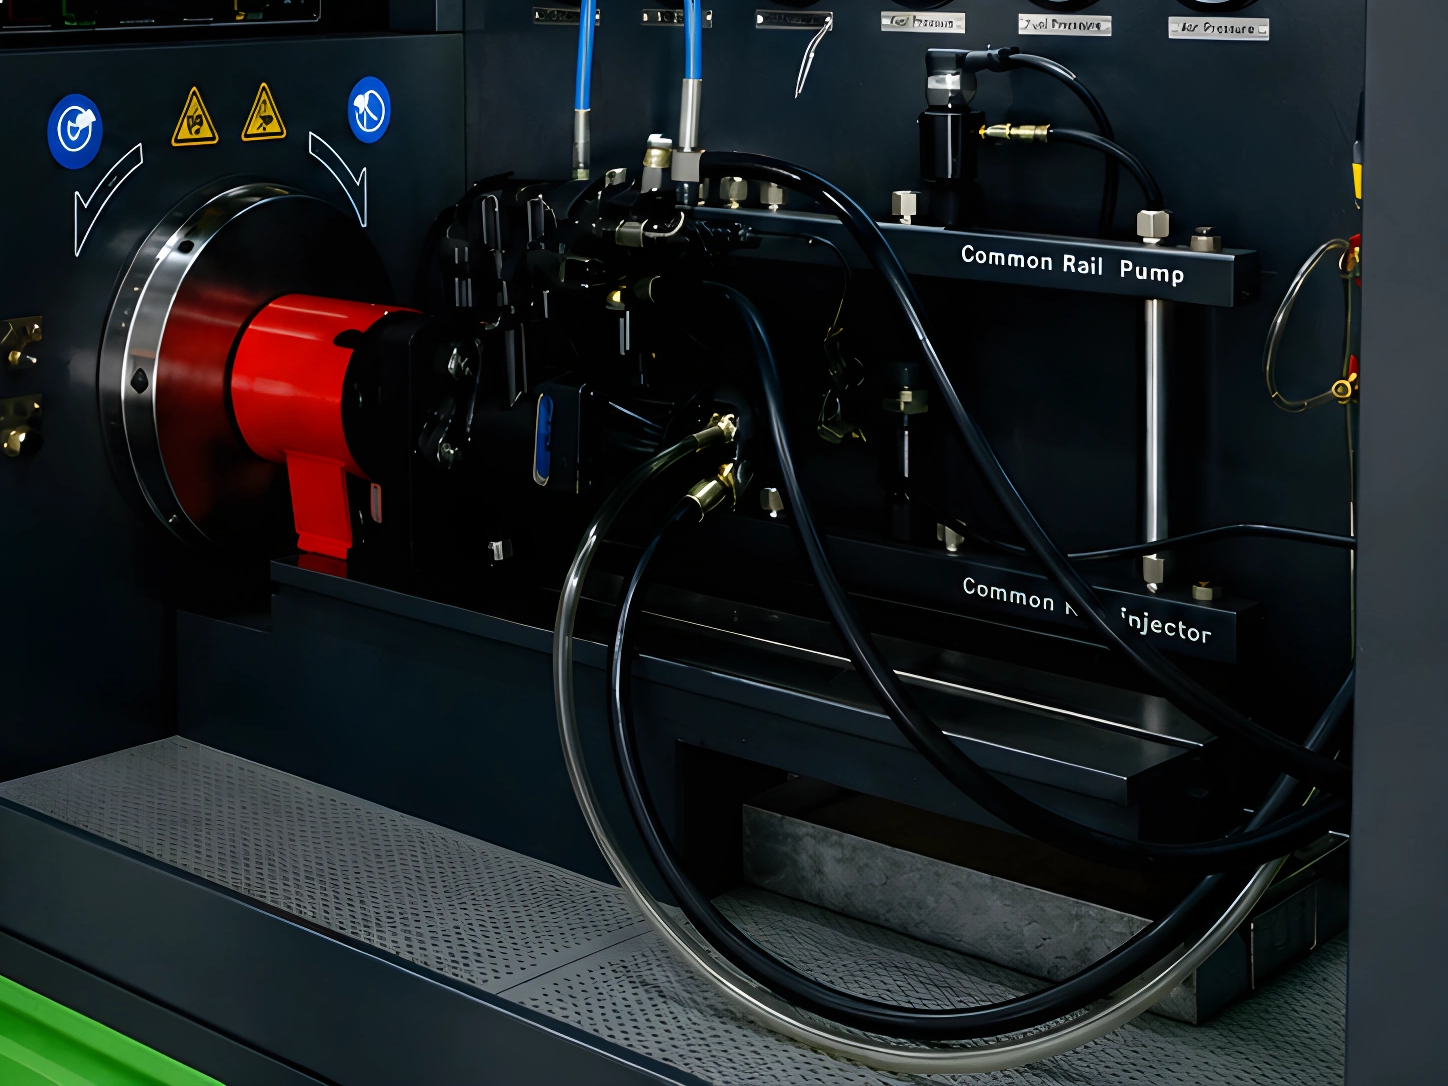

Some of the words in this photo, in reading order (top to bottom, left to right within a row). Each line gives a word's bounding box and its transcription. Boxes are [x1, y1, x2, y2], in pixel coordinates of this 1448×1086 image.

[961, 244, 1052, 271] Common
[1063, 254, 1103, 276] Rail
[1120, 259, 1184, 288] Pump
[963, 577, 1054, 611] Common
